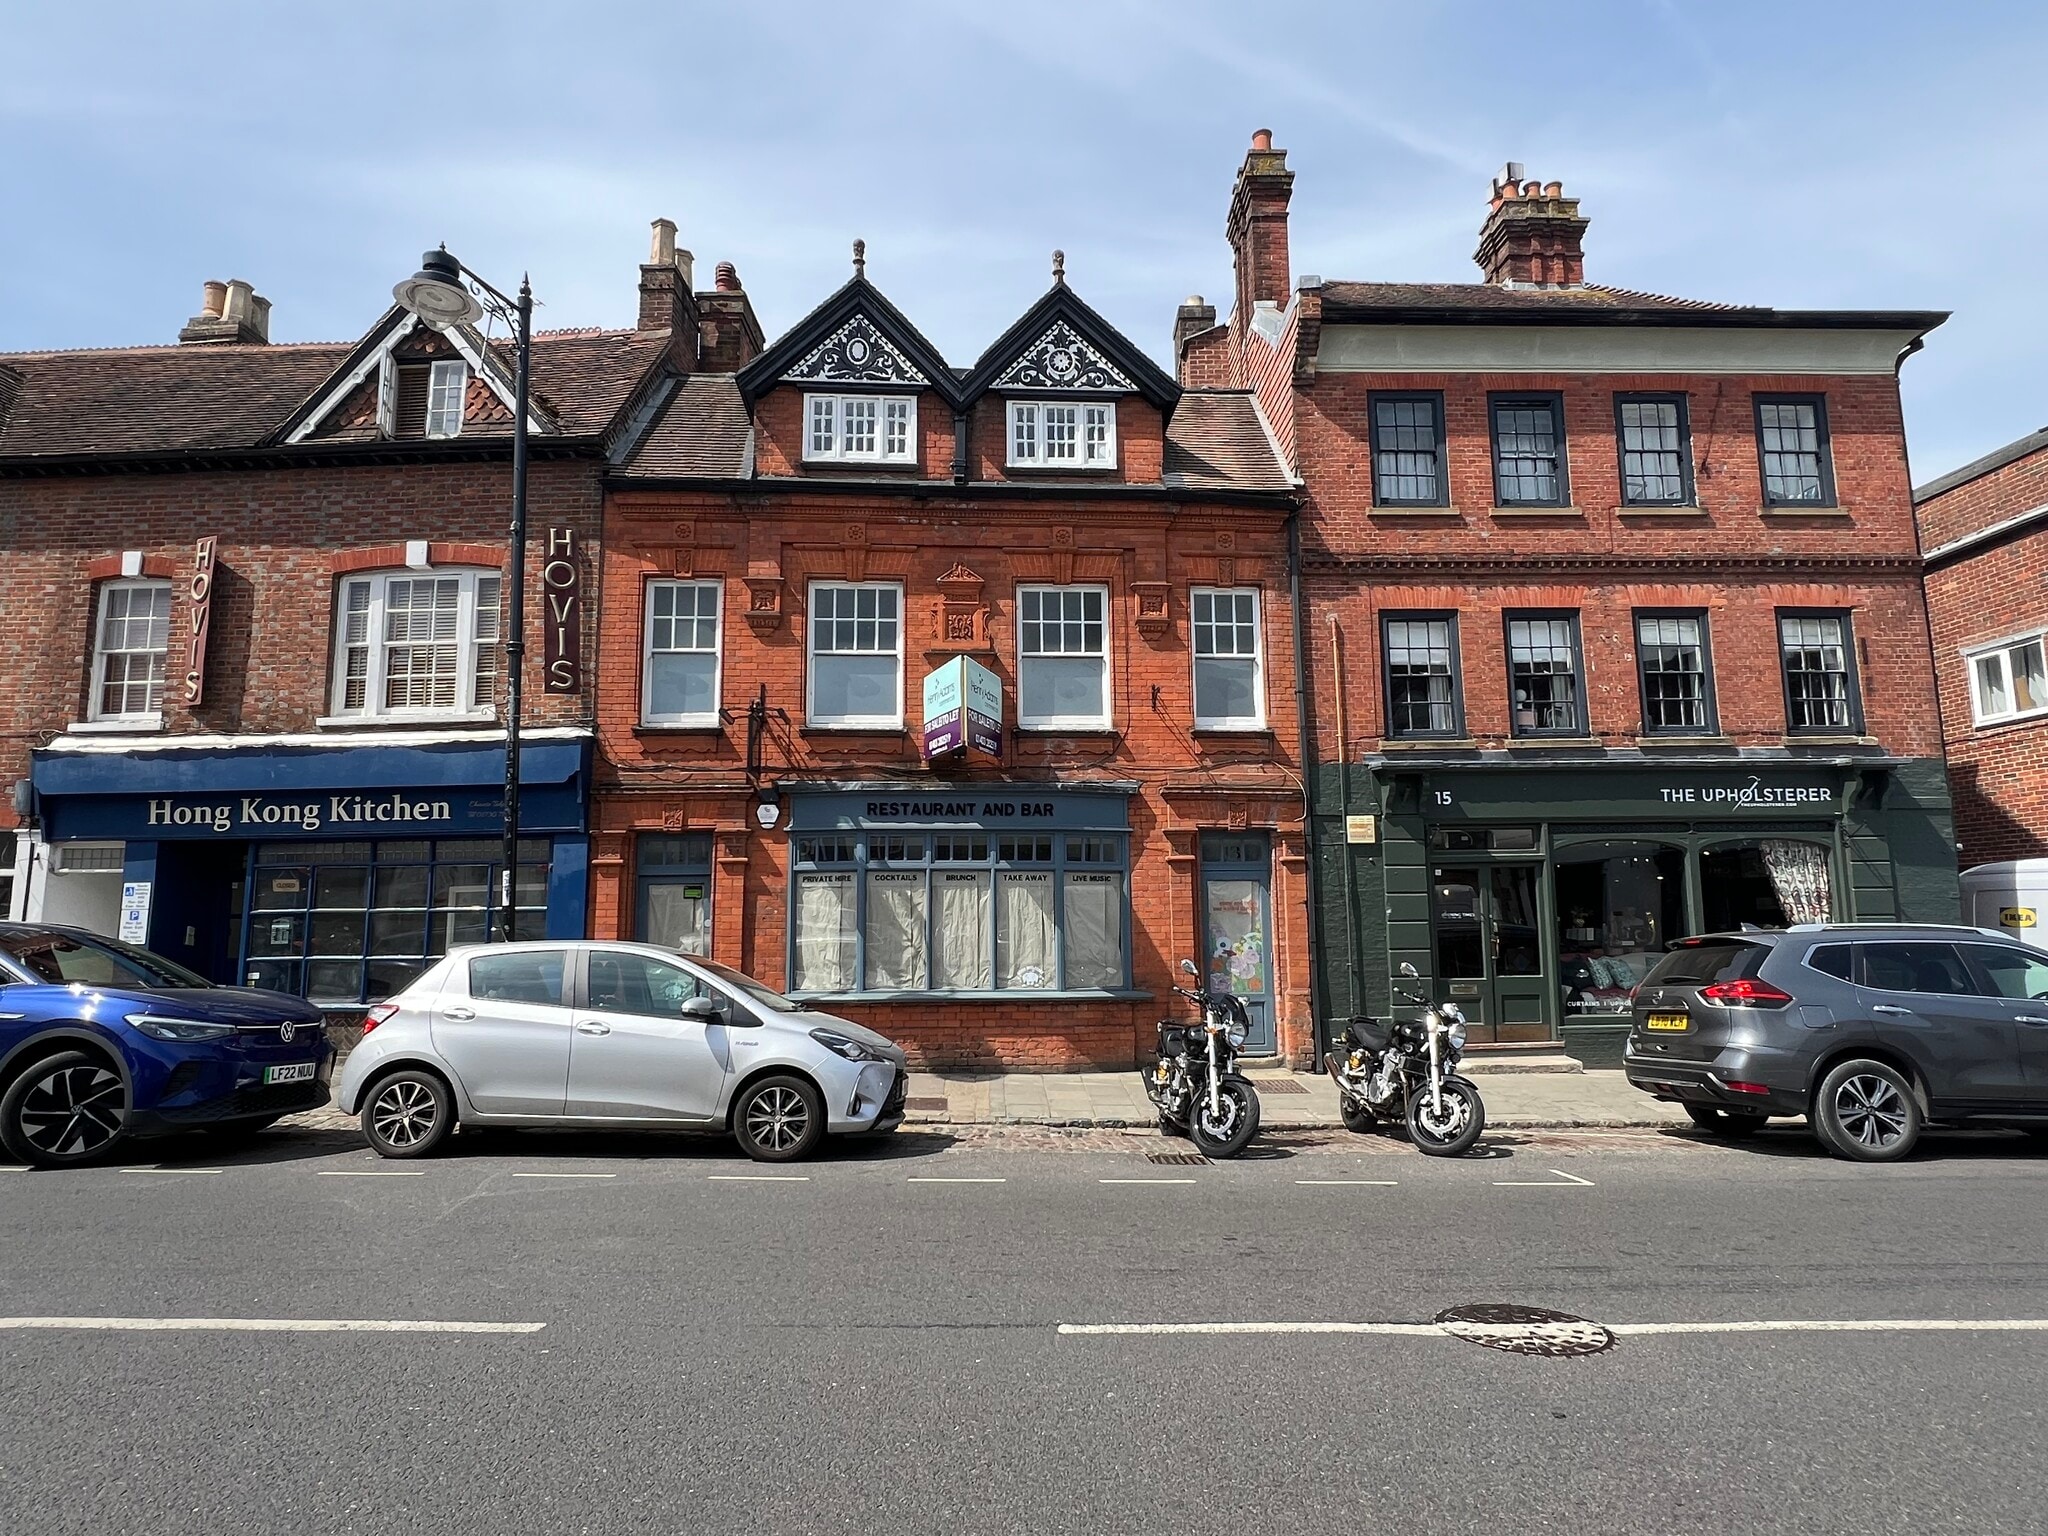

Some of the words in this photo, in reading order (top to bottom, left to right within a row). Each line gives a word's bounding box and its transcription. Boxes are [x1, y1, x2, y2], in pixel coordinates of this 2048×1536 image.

[544, 528, 576, 690] HOVIS
[184, 540, 213, 701] HOVIS
[1434, 791, 1452, 805] 15
[1660, 788, 1696, 802] THE
[1702, 788, 1832, 802] UPHOLSTERER
[147, 799, 232, 832] Hong
[239, 798, 321, 831] Kong
[329, 795, 451, 823] Kitchen
[866, 802, 977, 816] RESTAURANT
[982, 803, 1016, 816] AND
[1020, 803, 1055, 816] BAR
[1025, 874, 1048, 882] AWAY
[2004, 913, 2033, 922] IKEA
[272, 1066, 296, 1081] LF22
[297, 1064, 314, 1079] NUU
